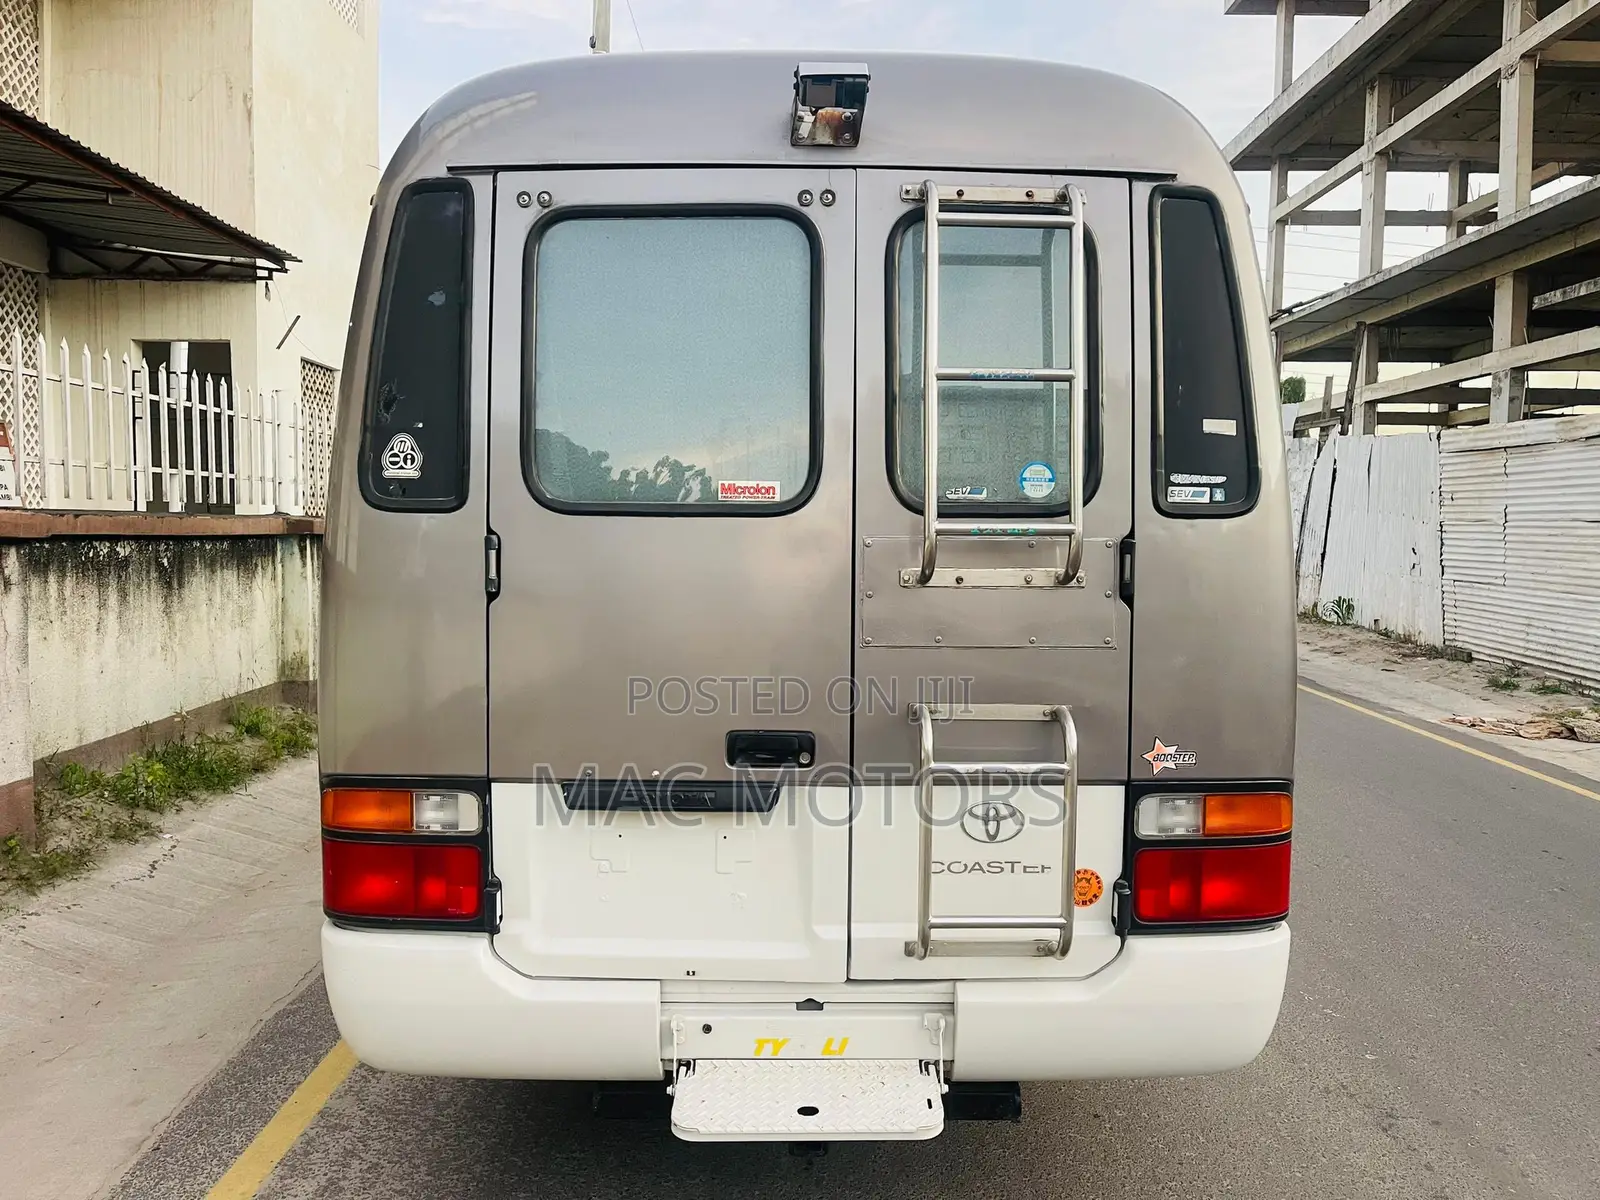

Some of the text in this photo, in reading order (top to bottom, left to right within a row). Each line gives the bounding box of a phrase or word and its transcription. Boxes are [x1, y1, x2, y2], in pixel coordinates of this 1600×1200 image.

[720, 483, 776, 495] Microlon
[1169, 489, 1191, 498] SEV
[1152, 753, 1195, 762] BOOSTER
[753, 1038, 790, 1056] TY
